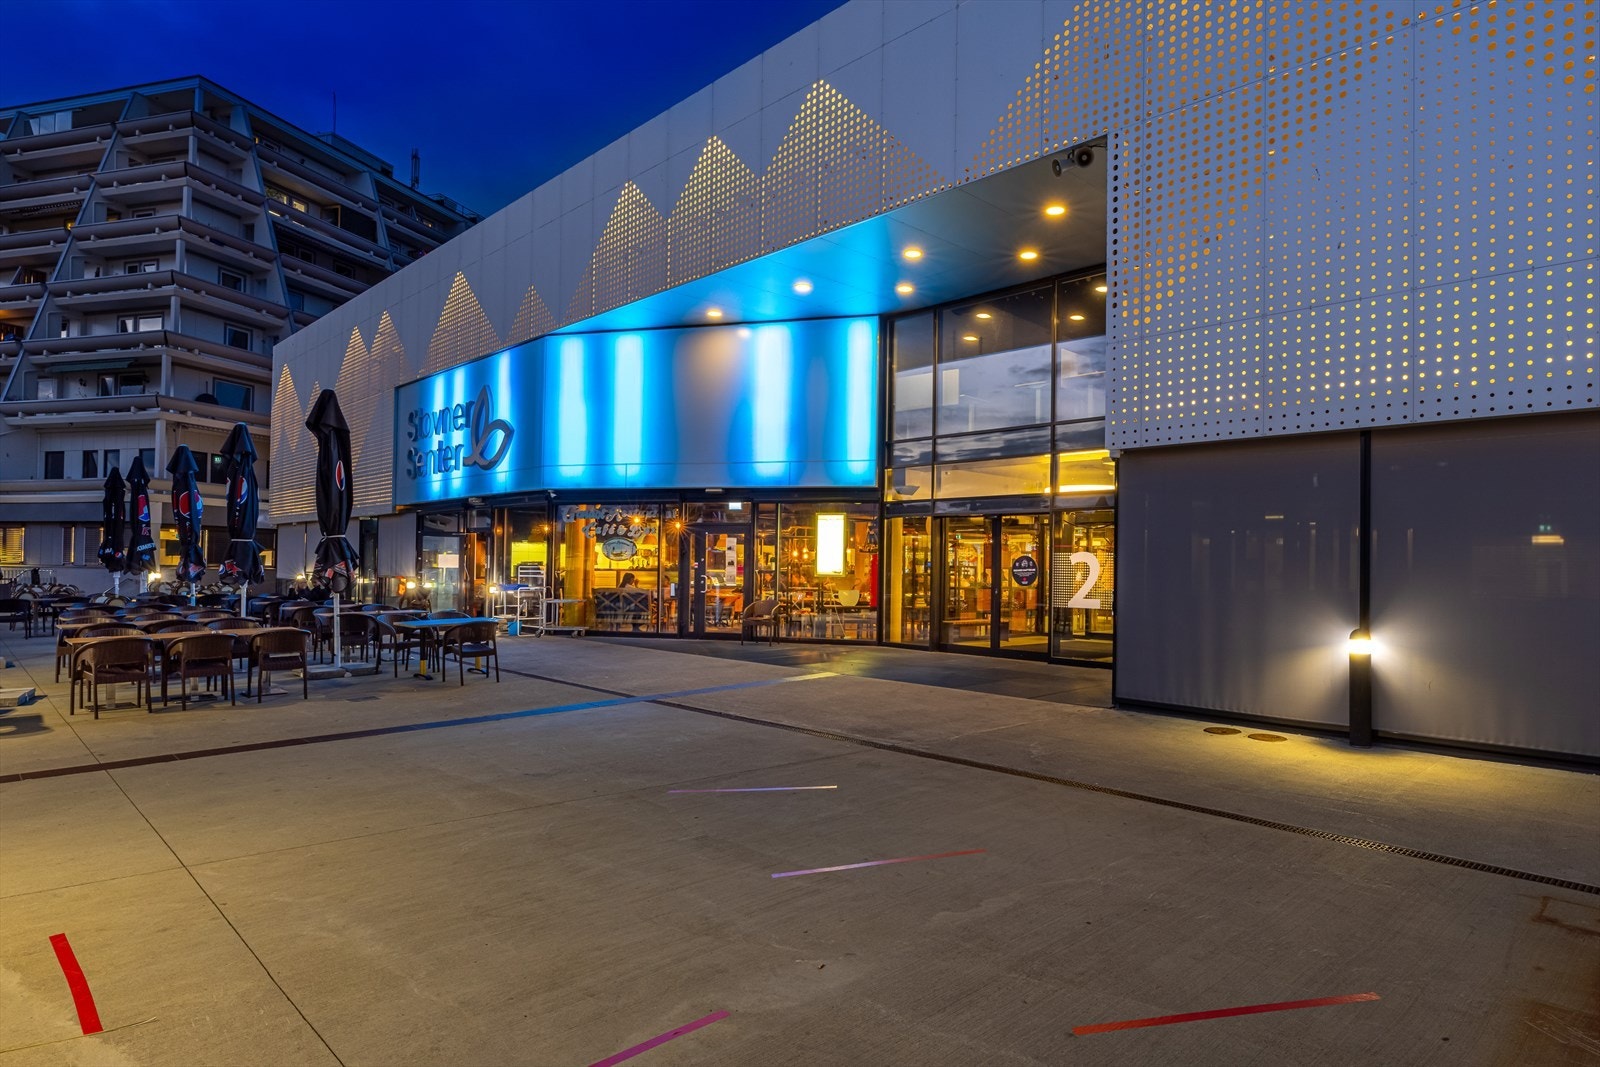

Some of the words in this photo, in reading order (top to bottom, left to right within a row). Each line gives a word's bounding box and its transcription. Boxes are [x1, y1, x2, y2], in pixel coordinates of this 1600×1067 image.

[407, 400, 475, 442] Stovner
[406, 440, 464, 480] Senter
[1068, 551, 1101, 609] 2
